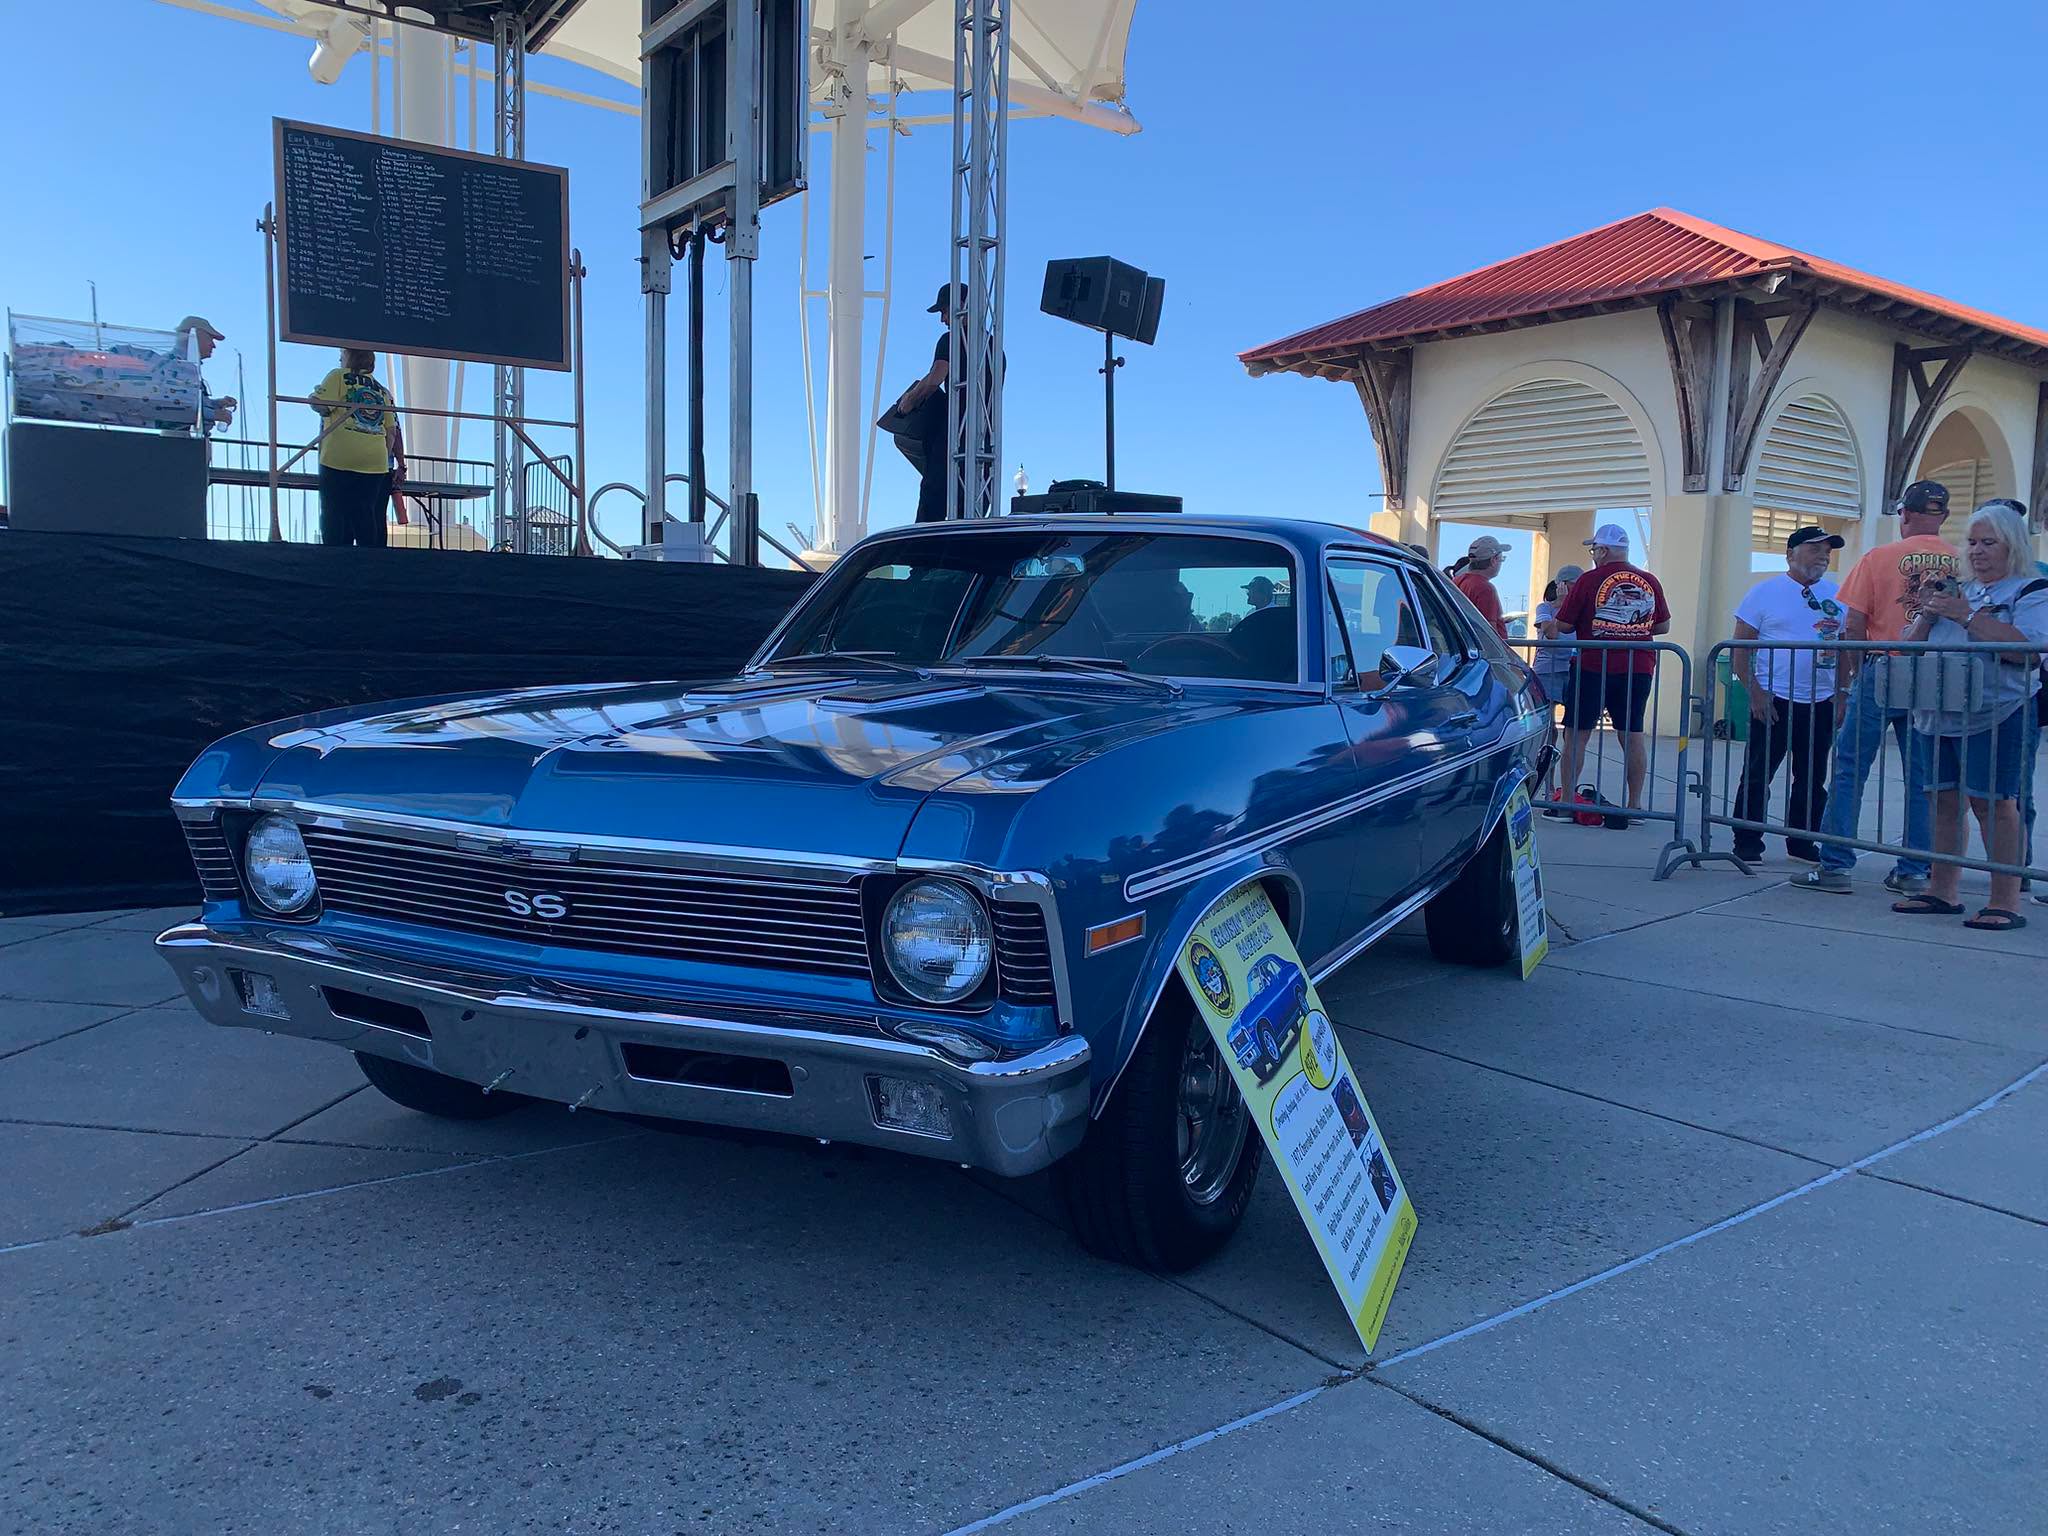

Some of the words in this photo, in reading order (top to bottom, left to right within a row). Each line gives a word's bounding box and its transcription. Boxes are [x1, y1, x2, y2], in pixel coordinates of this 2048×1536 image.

[287, 133, 308, 146] Early
[1898, 553, 1961, 576] CRUISI
[504, 890, 566, 918] SS
[1304, 1048, 1318, 1079] 1972
[1290, 1147, 1303, 1166] 1972
[1298, 1132, 1314, 1156] Chevrolet
